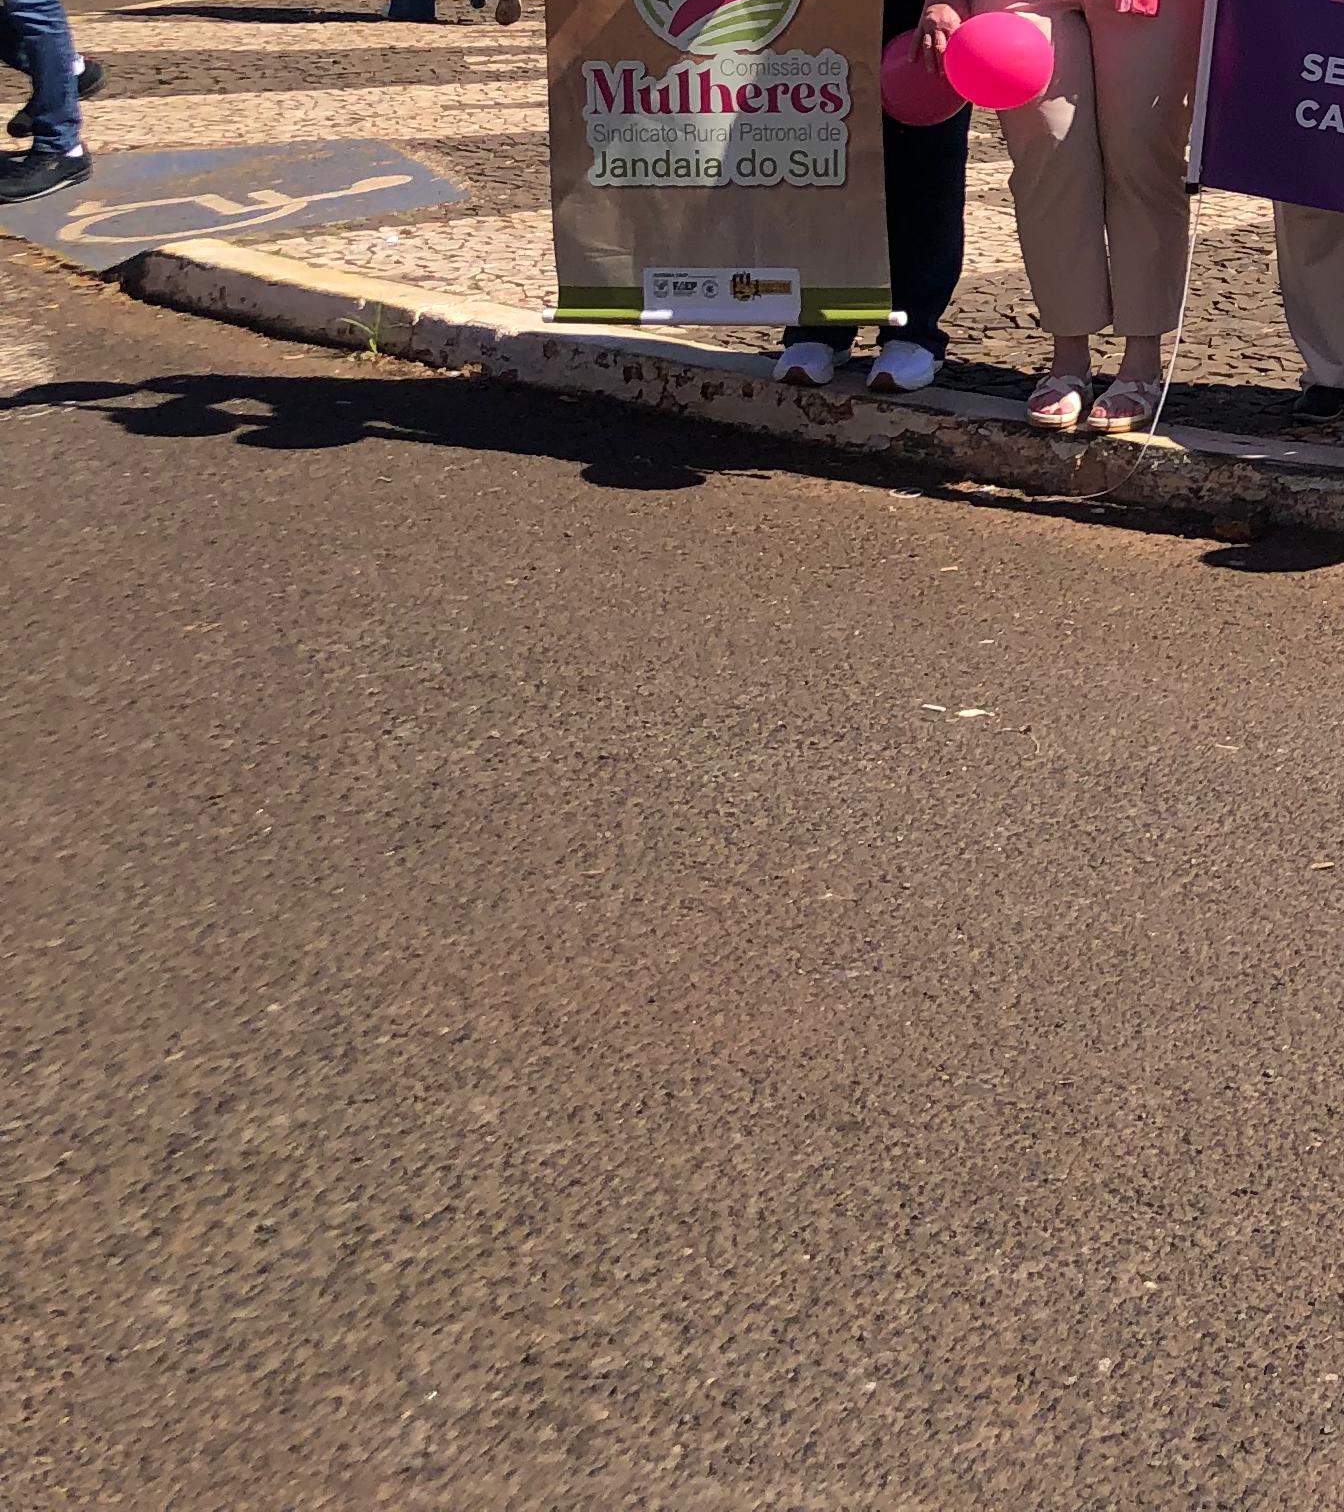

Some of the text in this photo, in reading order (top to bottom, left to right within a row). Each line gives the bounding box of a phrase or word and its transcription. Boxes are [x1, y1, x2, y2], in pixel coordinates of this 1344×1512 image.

[720, 59, 841, 78] Comissão de
[589, 68, 844, 115] Mulheres
[593, 123, 841, 144] Sindicato Rural Patronal de
[595, 150, 840, 180] Jandaia do Sul
